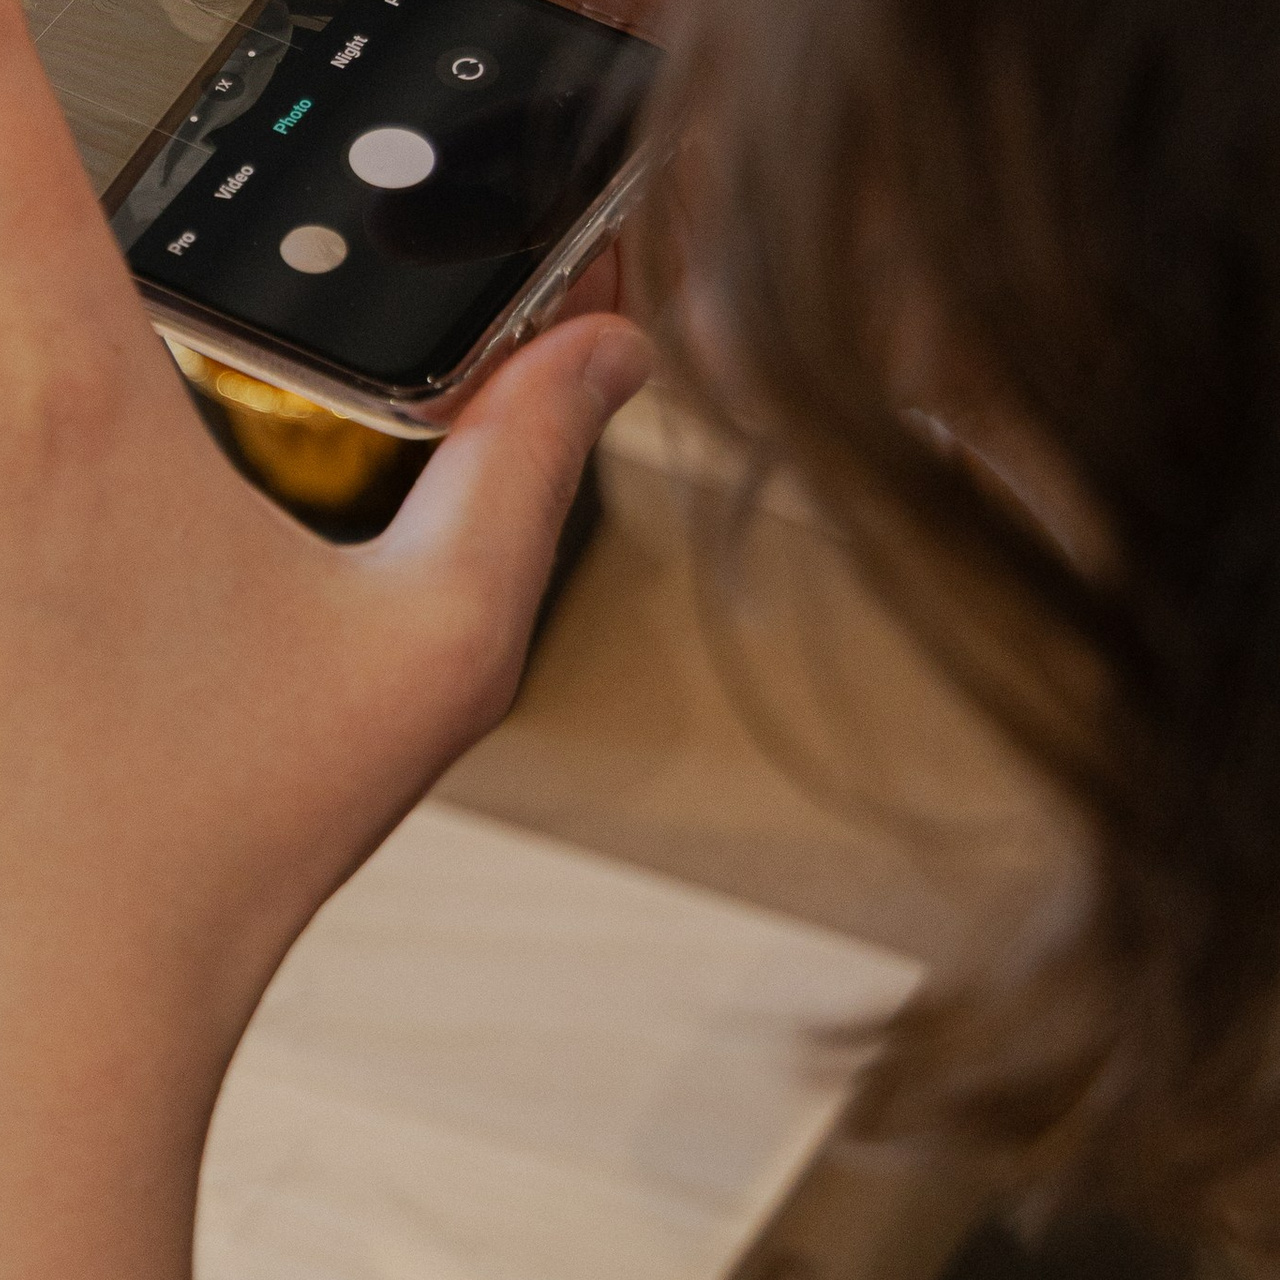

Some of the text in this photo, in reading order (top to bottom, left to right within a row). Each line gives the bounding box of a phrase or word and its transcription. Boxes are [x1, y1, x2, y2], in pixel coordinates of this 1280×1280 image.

[215, 79, 233, 92] 1X
[167, 232, 196, 256] Pro
[214, 165, 254, 199] Video
[273, 99, 312, 134] Photo
[330, 35, 368, 69] Night
